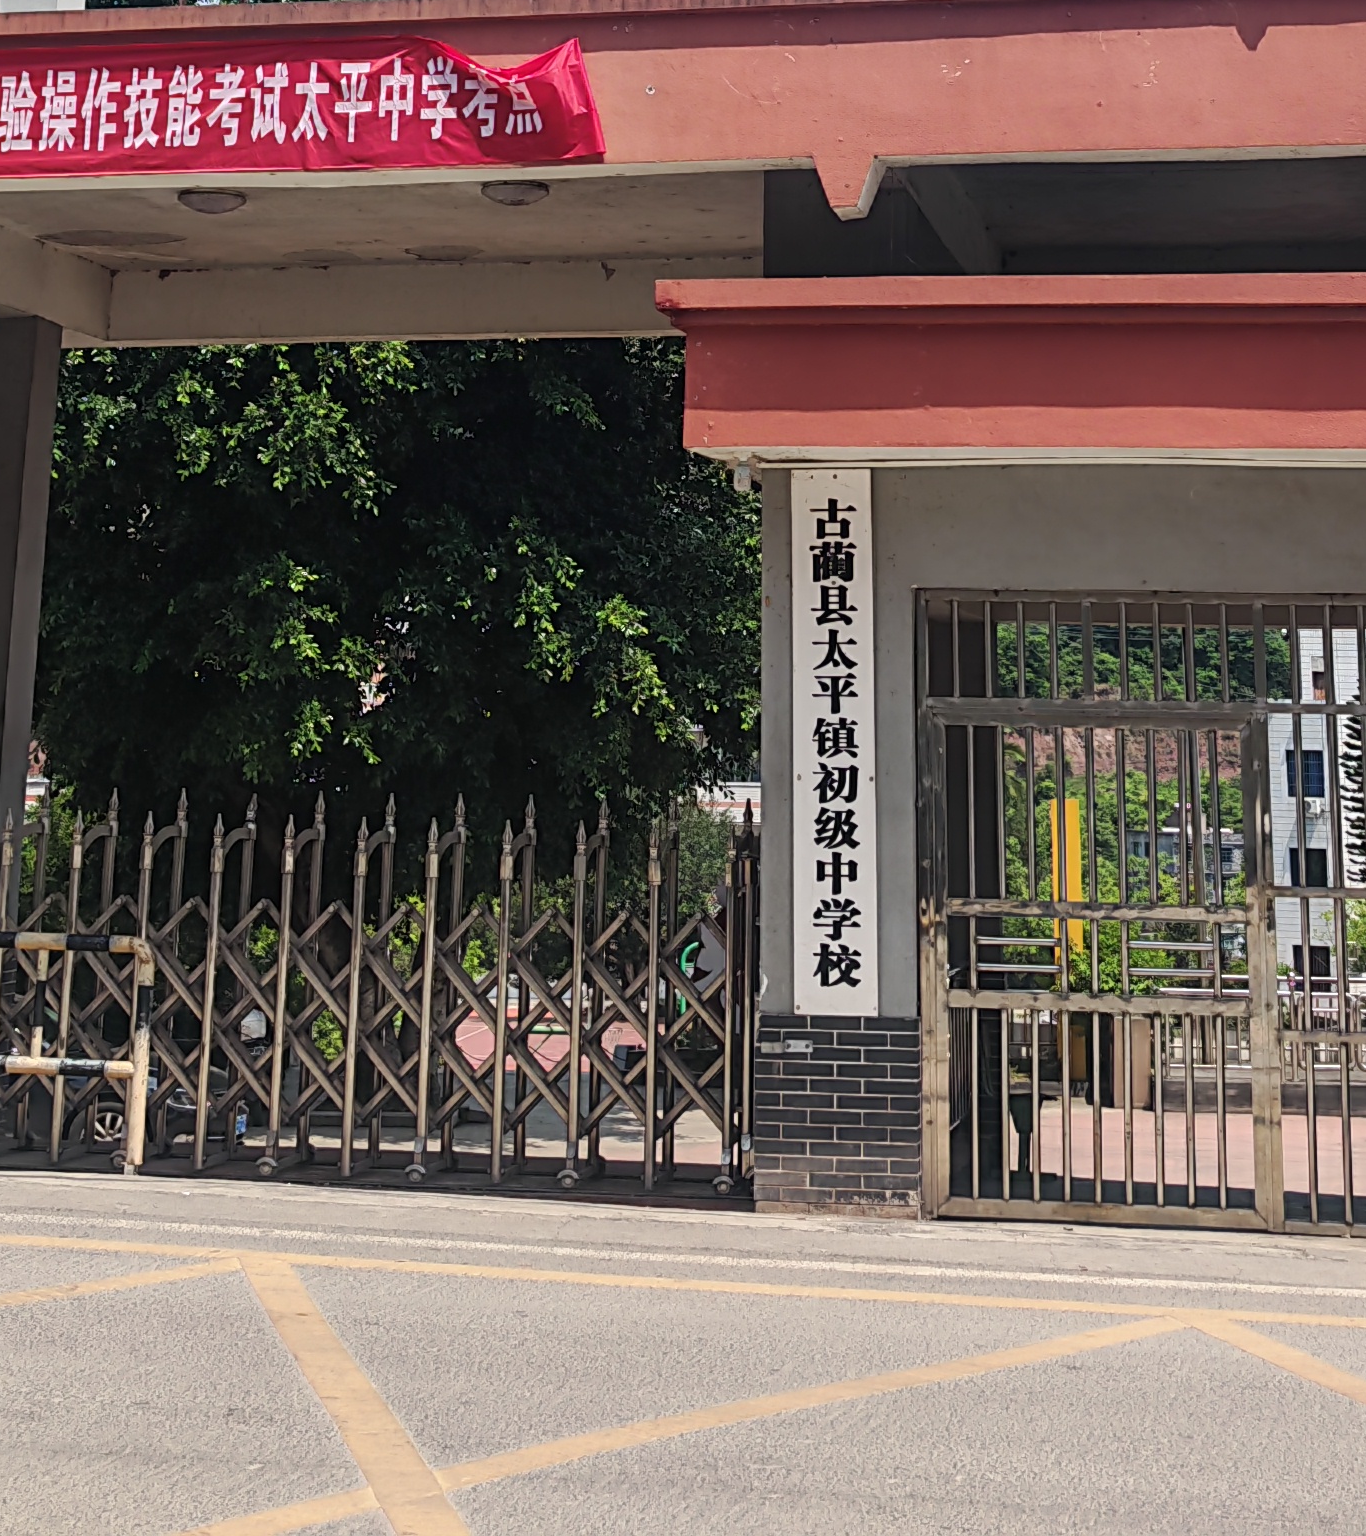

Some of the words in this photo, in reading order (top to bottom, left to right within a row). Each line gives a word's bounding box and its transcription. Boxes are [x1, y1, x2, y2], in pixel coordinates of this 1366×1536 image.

[810, 498, 862, 988] 古蔺县太平镇初级中学校
